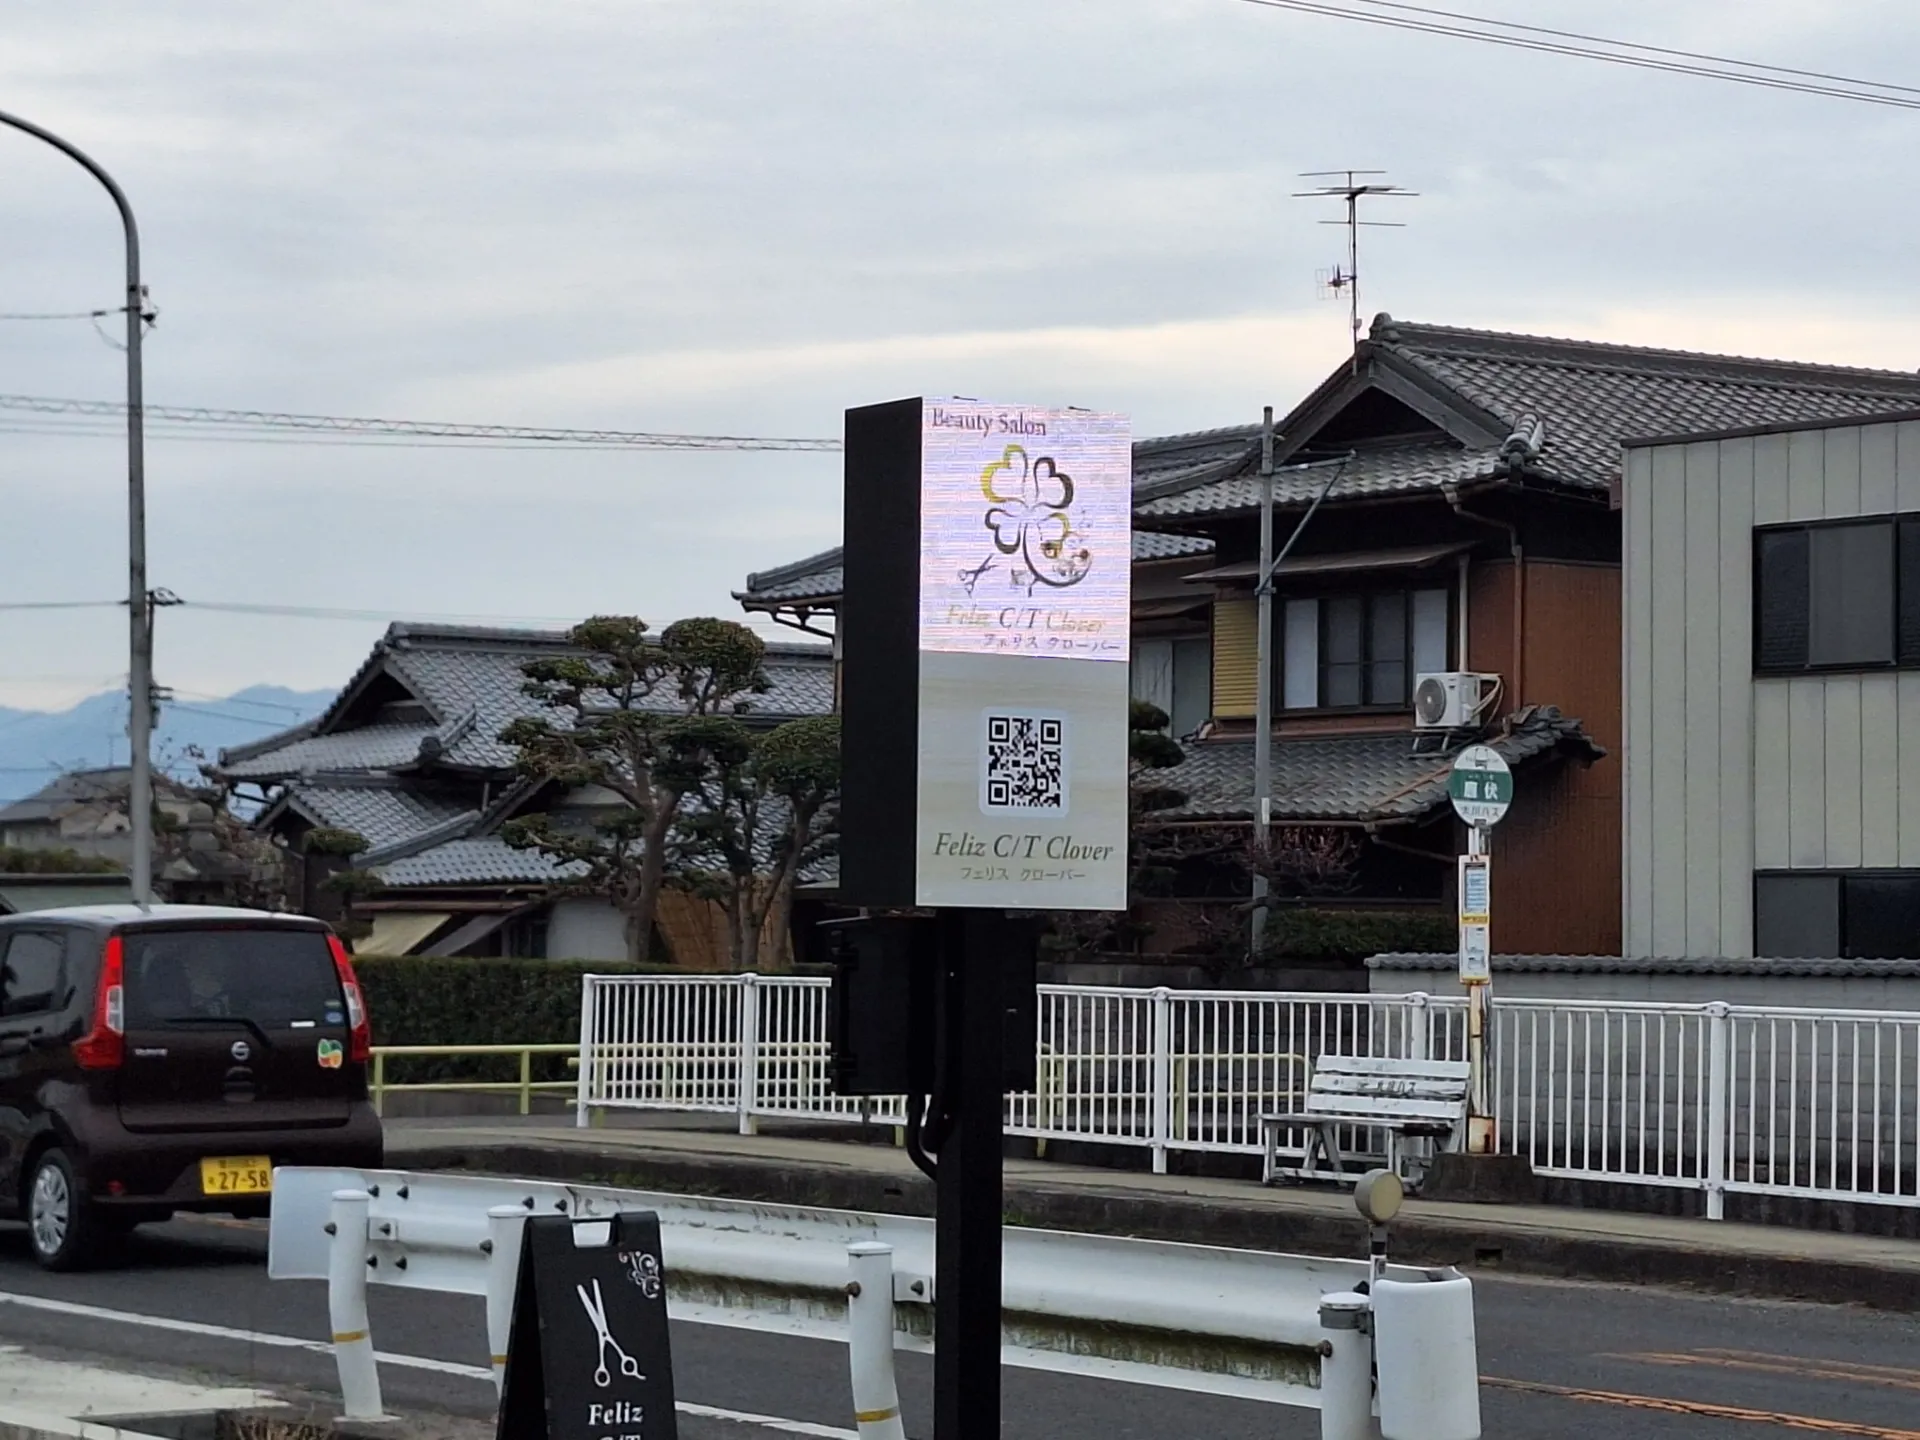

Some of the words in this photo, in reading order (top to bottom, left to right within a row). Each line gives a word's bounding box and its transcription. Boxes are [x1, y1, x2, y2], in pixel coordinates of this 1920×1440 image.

[932, 407, 993, 438] Beauty
[998, 411, 1047, 436] Salon
[999, 607, 1042, 630] C/T
[932, 832, 987, 858] Feliz
[993, 834, 1042, 859] C/T
[1047, 836, 1115, 861] Clover
[960, 866, 1010, 881] フェリス
[1020, 868, 1087, 882] クローバー
[218, 1169, 269, 1190] 27-58
[588, 1401, 644, 1426] Feliz
